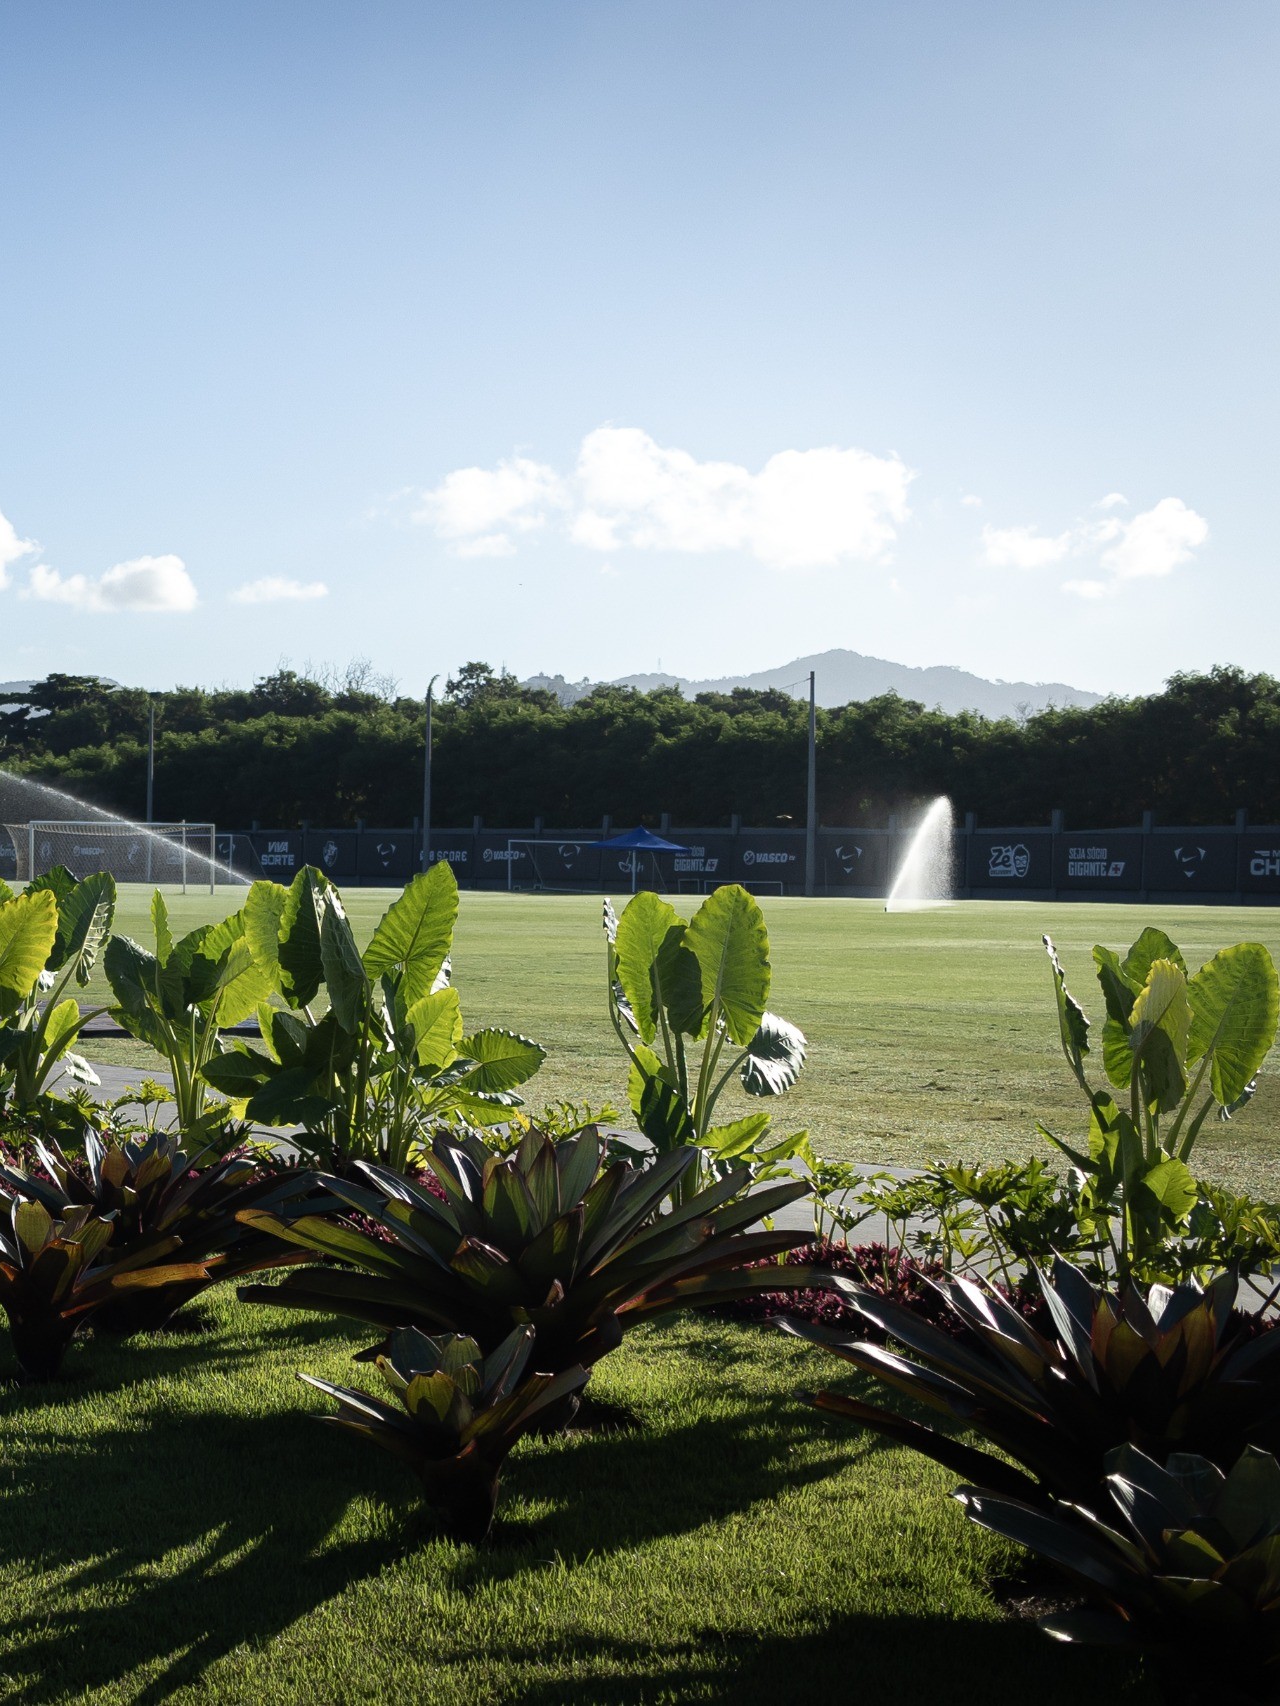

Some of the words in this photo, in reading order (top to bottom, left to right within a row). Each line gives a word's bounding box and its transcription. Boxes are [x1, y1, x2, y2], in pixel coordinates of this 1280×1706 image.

[268, 841, 289, 852] VIVA
[437, 851, 467, 862] SCORE
[494, 851, 519, 860] VASCO
[756, 853, 788, 863] VASCO
[990, 847, 1012, 868] Zé
[1069, 848, 1085, 860] SEJA
[1087, 846, 1107, 860] SÓCIO
[261, 854, 294, 866] SORTE
[674, 859, 705, 872] GIGANTE
[1068, 862, 1107, 876] GIGANTE
